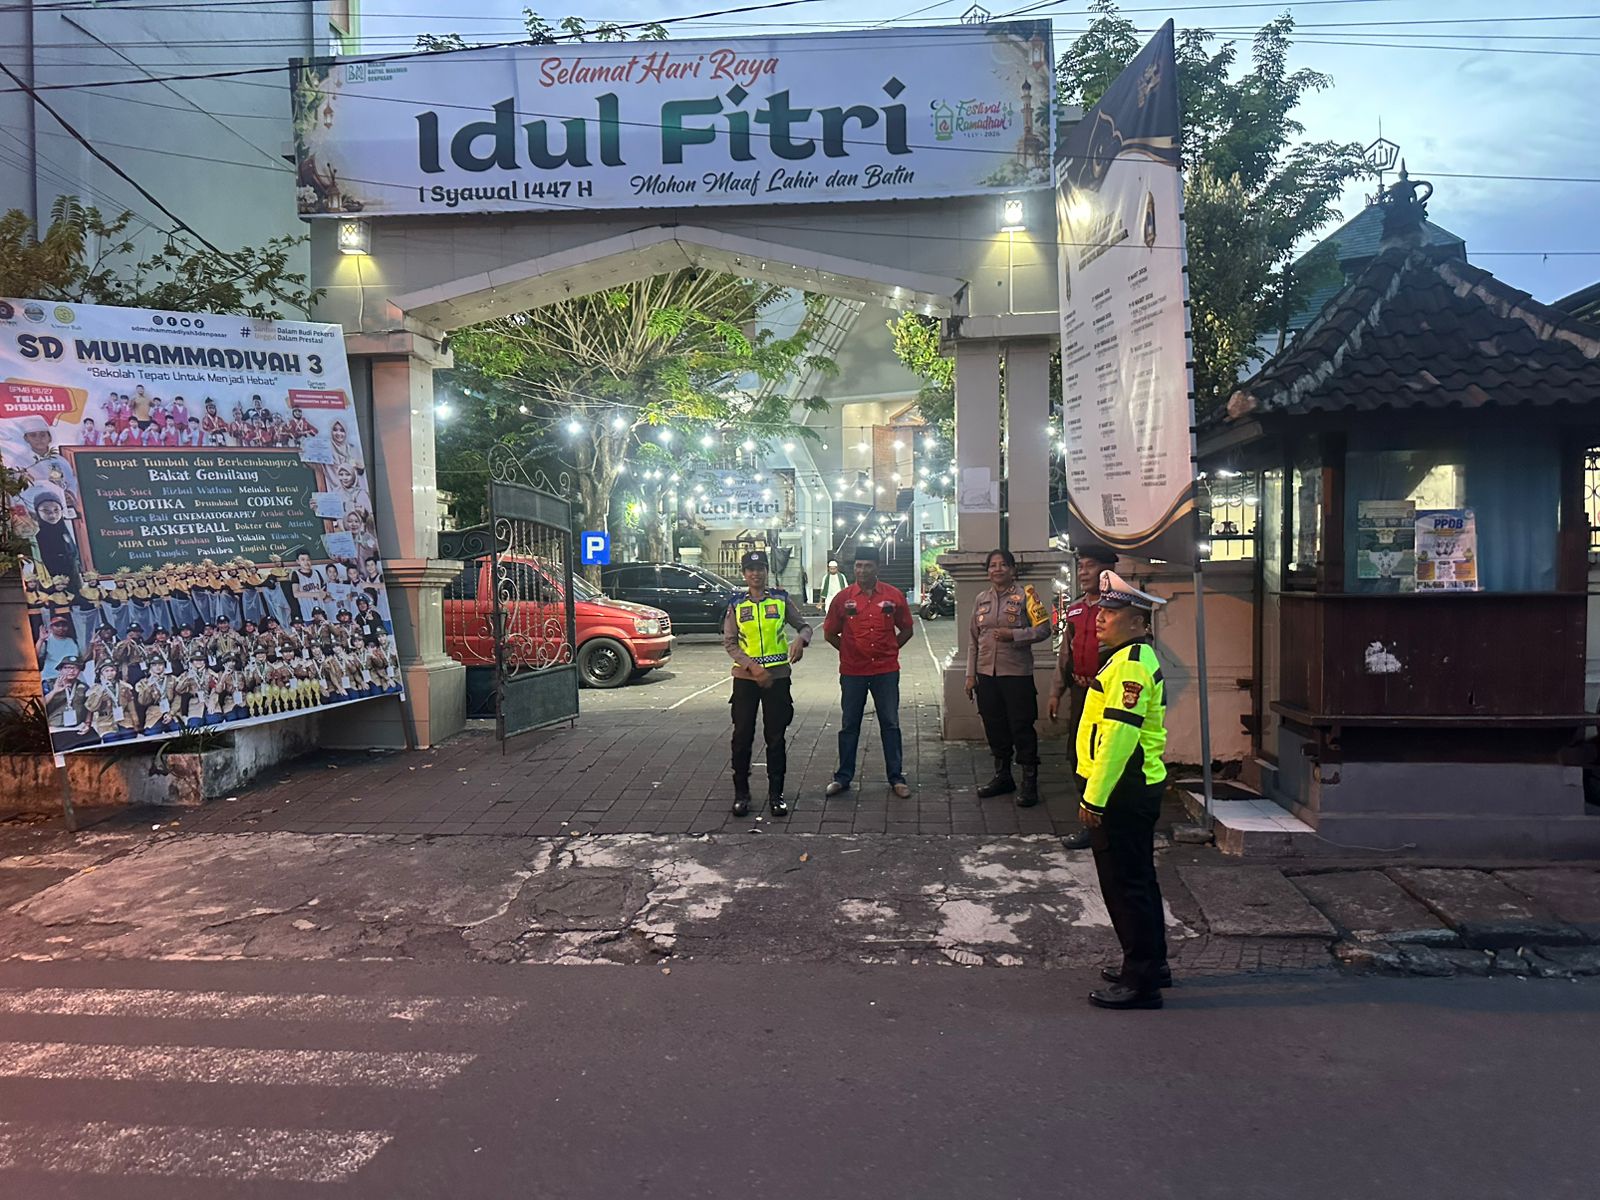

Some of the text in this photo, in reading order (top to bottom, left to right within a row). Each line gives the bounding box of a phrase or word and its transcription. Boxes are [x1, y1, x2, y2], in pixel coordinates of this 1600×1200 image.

[539, 49, 779, 87] Selamat Hari Raya
[956, 98, 1001, 116] Festival
[415, 76, 914, 174] Idul Fitri
[955, 114, 1007, 132] Ramadhan
[630, 164, 915, 197] Mohon Maaf Lahir dan Batin
[418, 180, 593, 207] 1 Syawal 1447 H
[131, 326, 227, 338] sdmuhammadiyah3denpasar
[277, 327, 297, 335] Dalam
[299, 328, 312, 336] Budi
[313, 329, 335, 338] Pekerti
[277, 334, 297, 342] Dalam
[299, 336, 323, 344] Prestasi
[17, 333, 323, 374] SD MUHAMMADIYAH 3
[138, 369, 170, 381] Tepat
[173, 372, 205, 382] Untuk
[208, 373, 244, 386] Menjadi
[32, 387, 52, 395] 26/27
[13, 395, 54, 403] TELAH
[4, 403, 65, 412] DIBUKA!!!
[94, 457, 298, 470] Tempat Tumbuh dan Berkembangnya
[148, 468, 258, 482] Bakat Gemilang
[96, 487, 152, 498] Tapak Suci
[196, 486, 232, 495] Wathan
[239, 485, 271, 494] Melukis
[108, 498, 185, 511] ROBOTIKA
[194, 499, 239, 507] Drumband
[247, 495, 293, 507] CODING
[695, 499, 780, 514] Idul Fitri
[113, 513, 168, 523] Sastra Bali
[173, 510, 256, 521] CINEMATOGRAPHY
[140, 521, 230, 537] BASKETBALL
[234, 521, 282, 530] Dokter Cilik
[288, 520, 314, 528] Atletik
[1433, 518, 1464, 529] PPDB
[100, 528, 134, 537] Renang
[118, 539, 168, 549] MIPA Club
[174, 537, 209, 545] Panahan
[216, 534, 266, 543] Bina Vokalia
[197, 547, 234, 556] Paskibra
[240, 543, 287, 553] English Club
[587, 536, 605, 559] P
[128, 549, 189, 560] Bulu Tangkis
